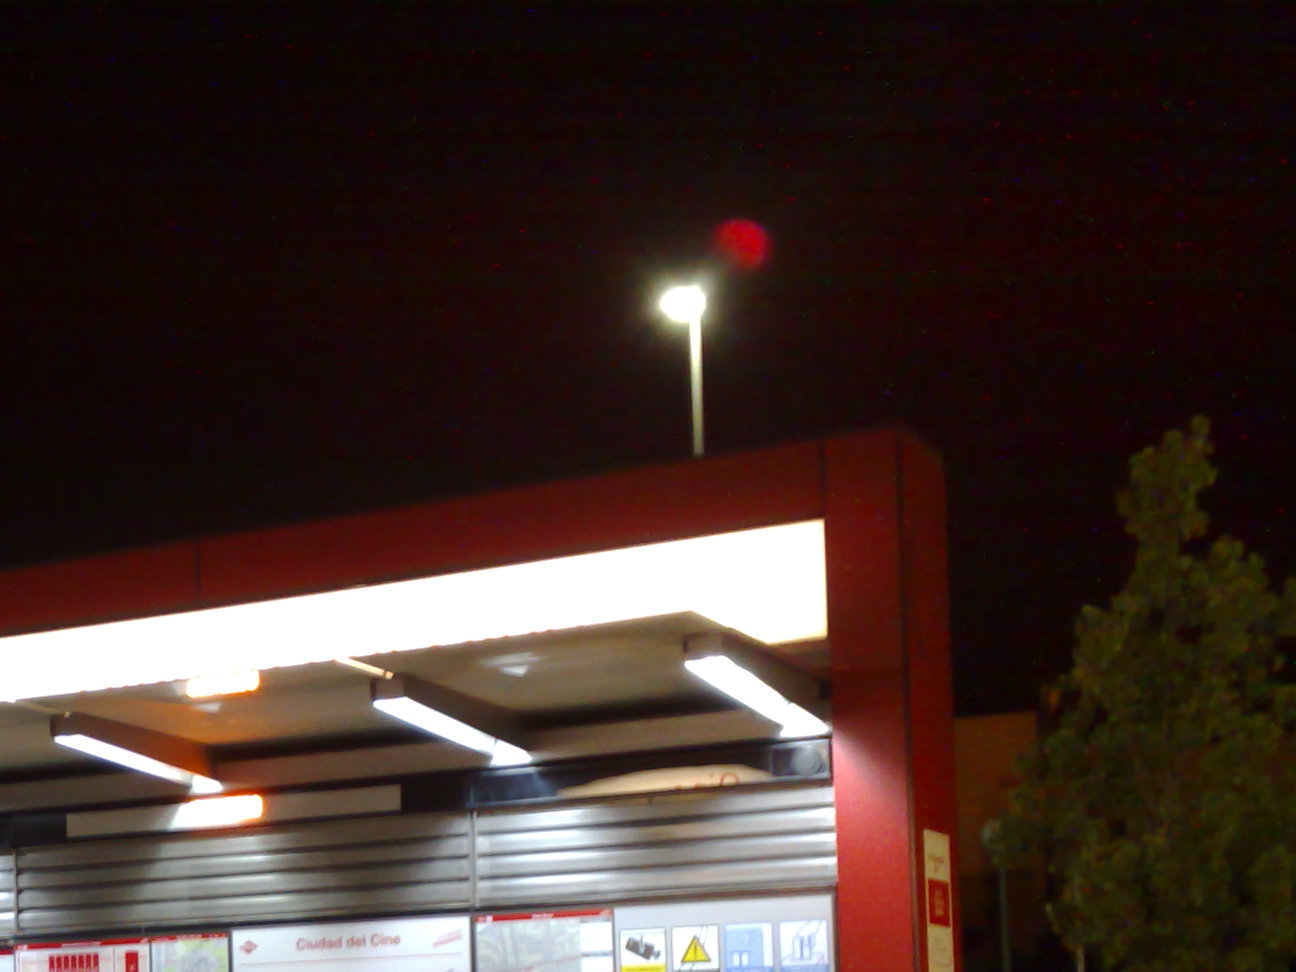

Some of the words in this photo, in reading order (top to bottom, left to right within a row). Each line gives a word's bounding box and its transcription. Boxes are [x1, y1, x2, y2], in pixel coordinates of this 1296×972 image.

[296, 936, 343, 951] Ciudad
[346, 934, 366, 948] del
[370, 932, 401, 948] Cine
